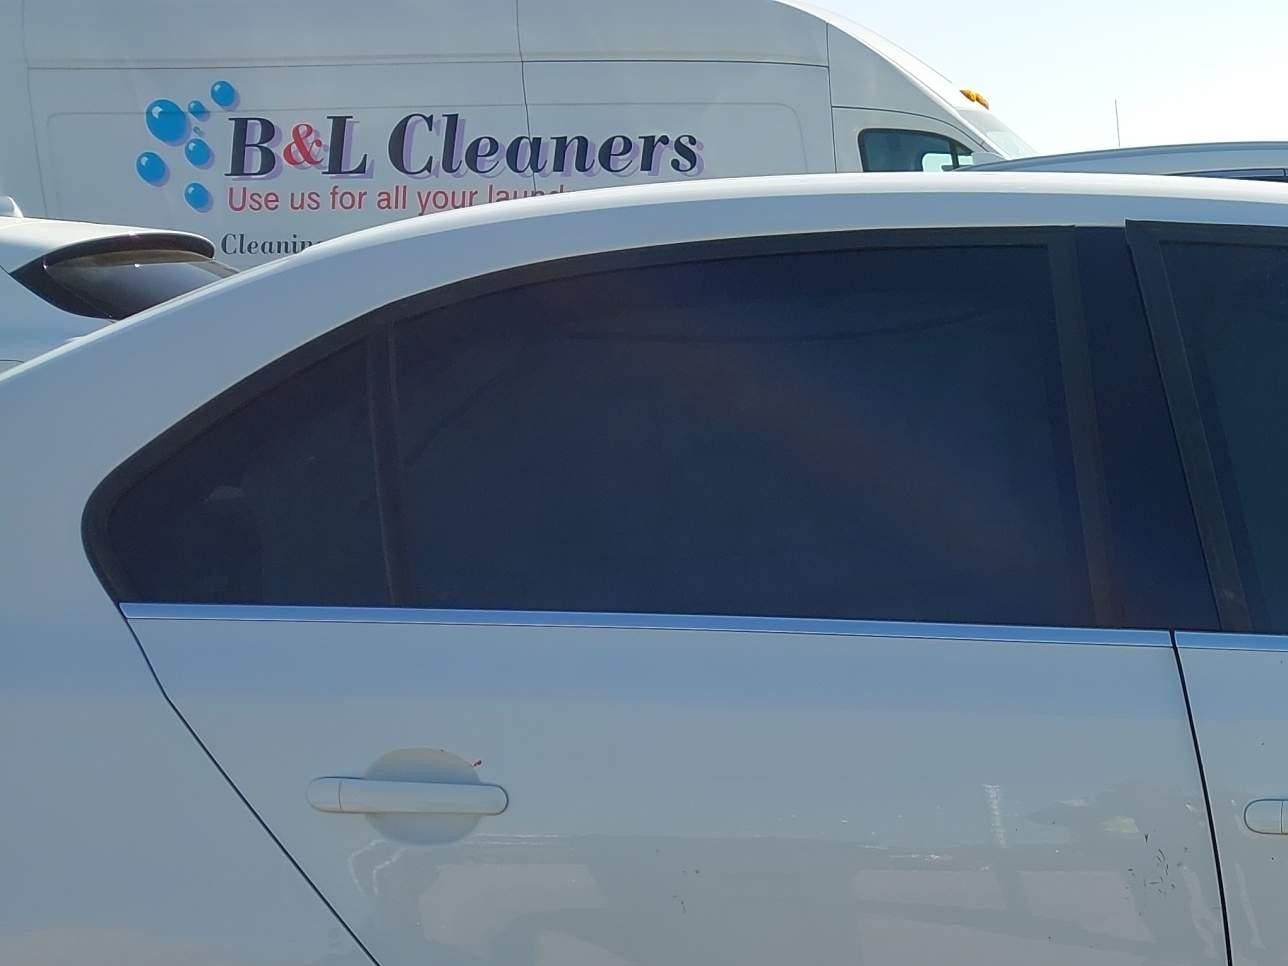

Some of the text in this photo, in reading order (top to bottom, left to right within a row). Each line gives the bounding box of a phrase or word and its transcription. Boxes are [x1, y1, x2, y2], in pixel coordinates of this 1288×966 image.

[224, 113, 700, 177] B&L Cleaners
[228, 186, 280, 212] Use
[290, 191, 321, 210] us
[330, 185, 368, 210] for
[377, 185, 407, 210] all
[417, 188, 478, 216] your
